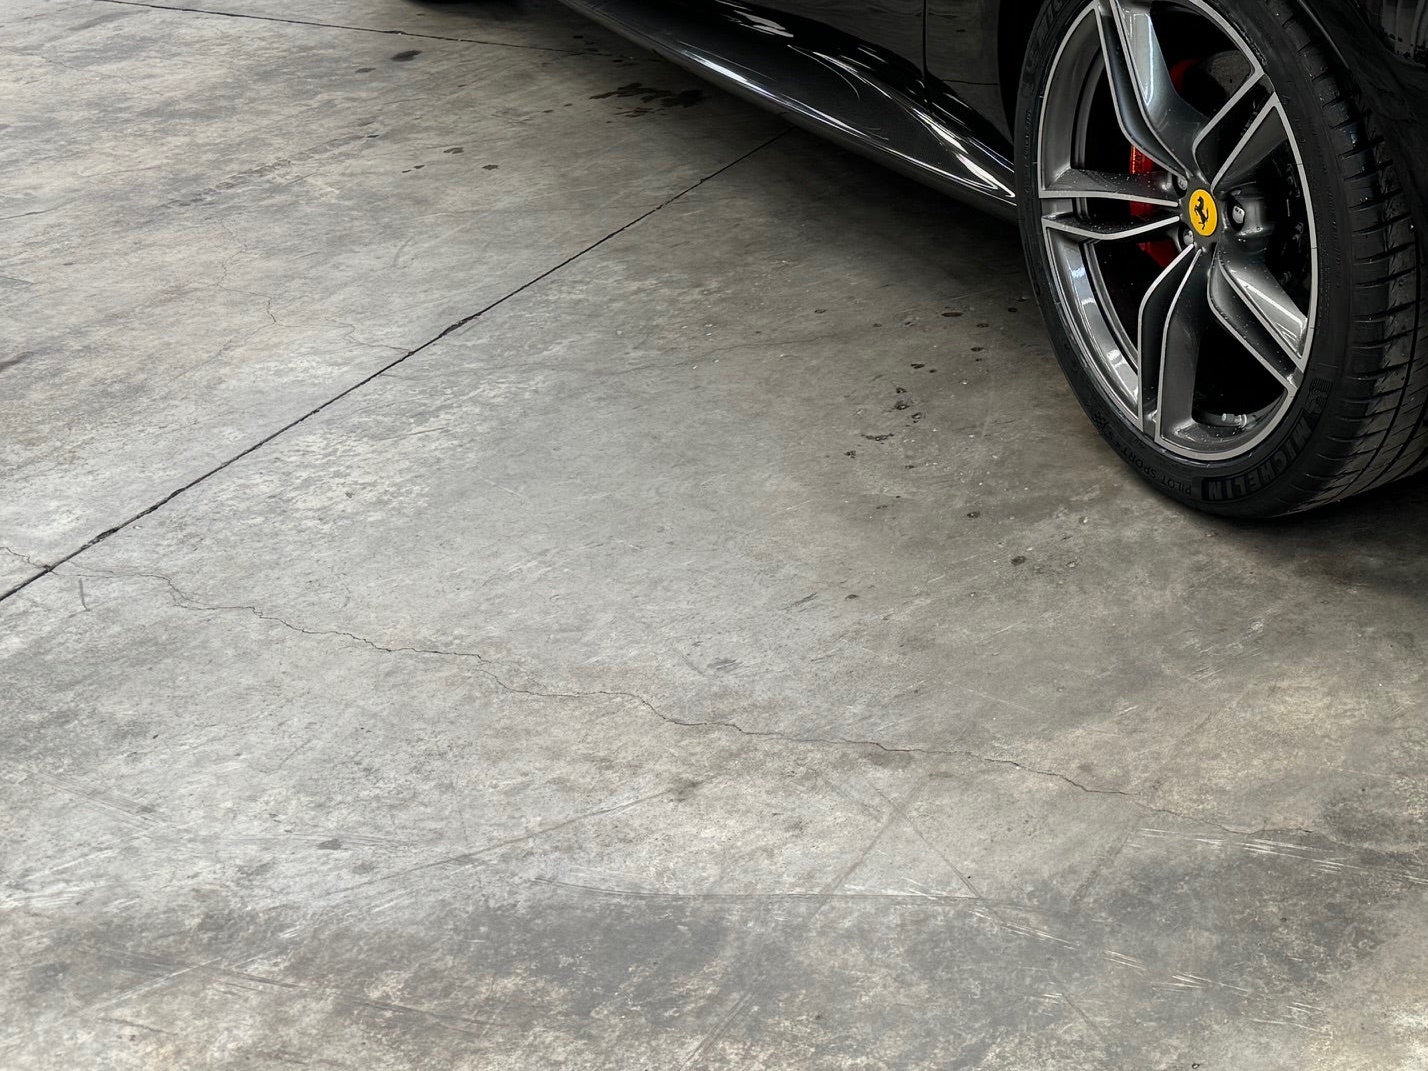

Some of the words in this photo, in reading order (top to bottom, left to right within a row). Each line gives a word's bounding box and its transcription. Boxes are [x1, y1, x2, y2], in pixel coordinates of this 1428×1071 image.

[1119, 446, 1157, 479] SPORT
[1208, 417, 1312, 500] MICHELIN
[1160, 475, 1191, 495] PILOT
